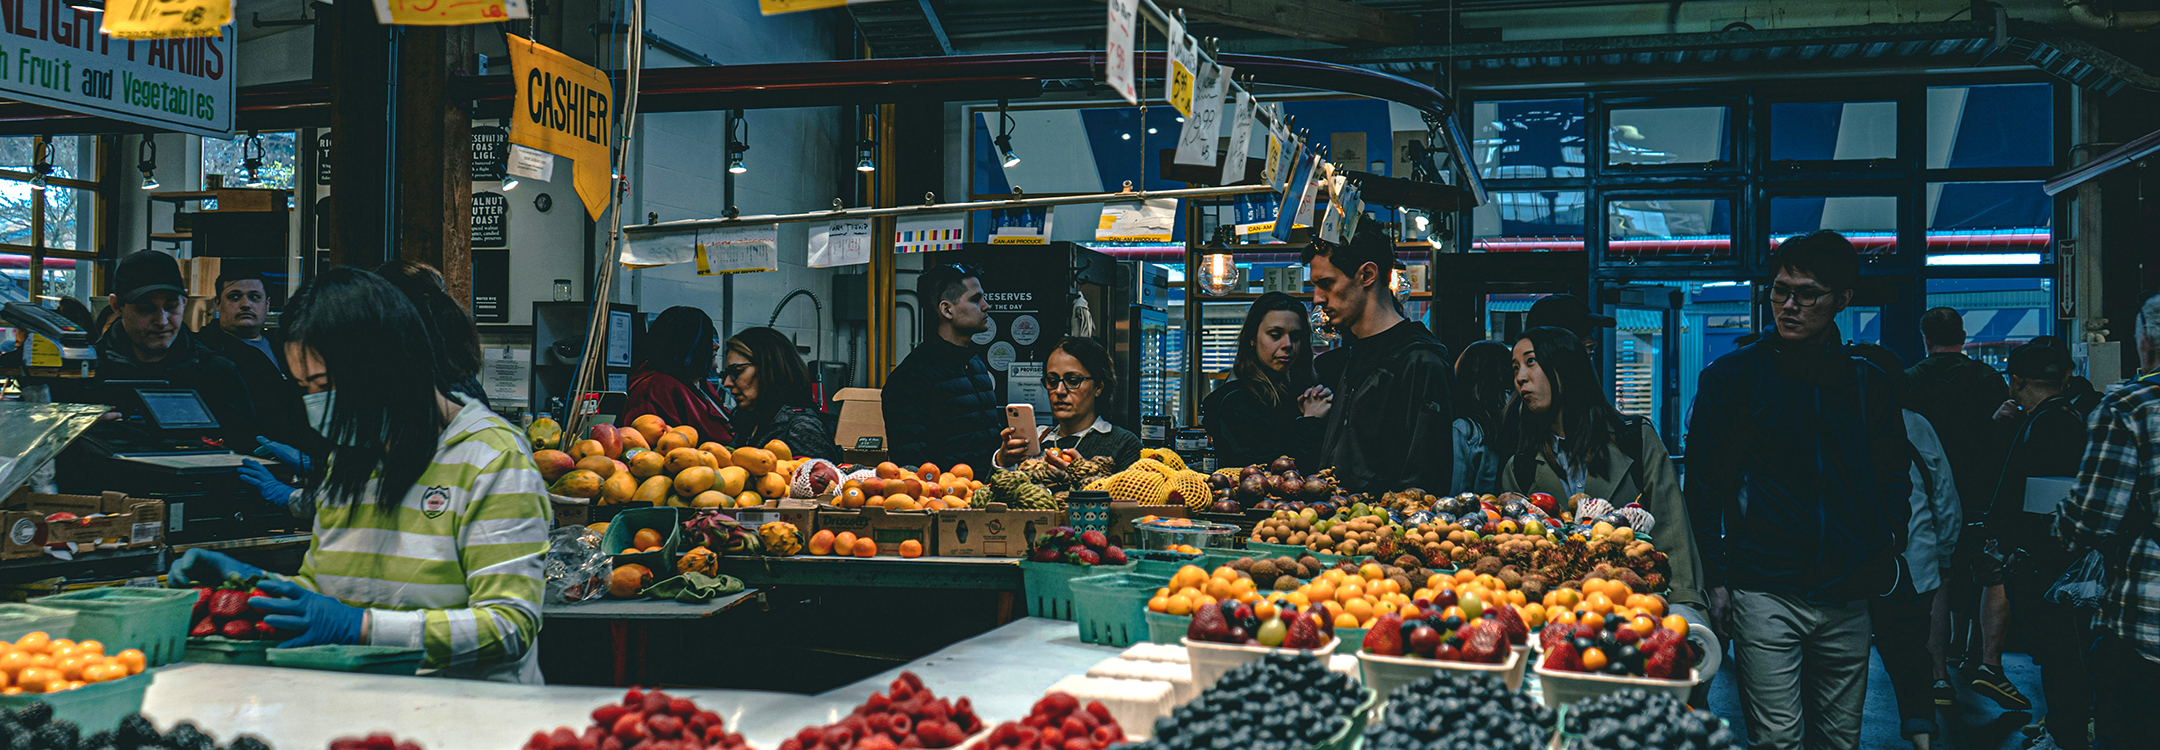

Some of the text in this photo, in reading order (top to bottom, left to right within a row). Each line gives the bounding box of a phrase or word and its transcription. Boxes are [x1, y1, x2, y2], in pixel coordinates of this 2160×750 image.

[127, 36, 224, 81] ARMS
[18, 47, 72, 91] Fruit
[82, 68, 113, 101] and
[122, 70, 215, 122] Vegetables
[528, 67, 608, 147] CASHIER
[472, 206, 503, 214] UTTER
[2061, 247, 2073, 255] FIRE
